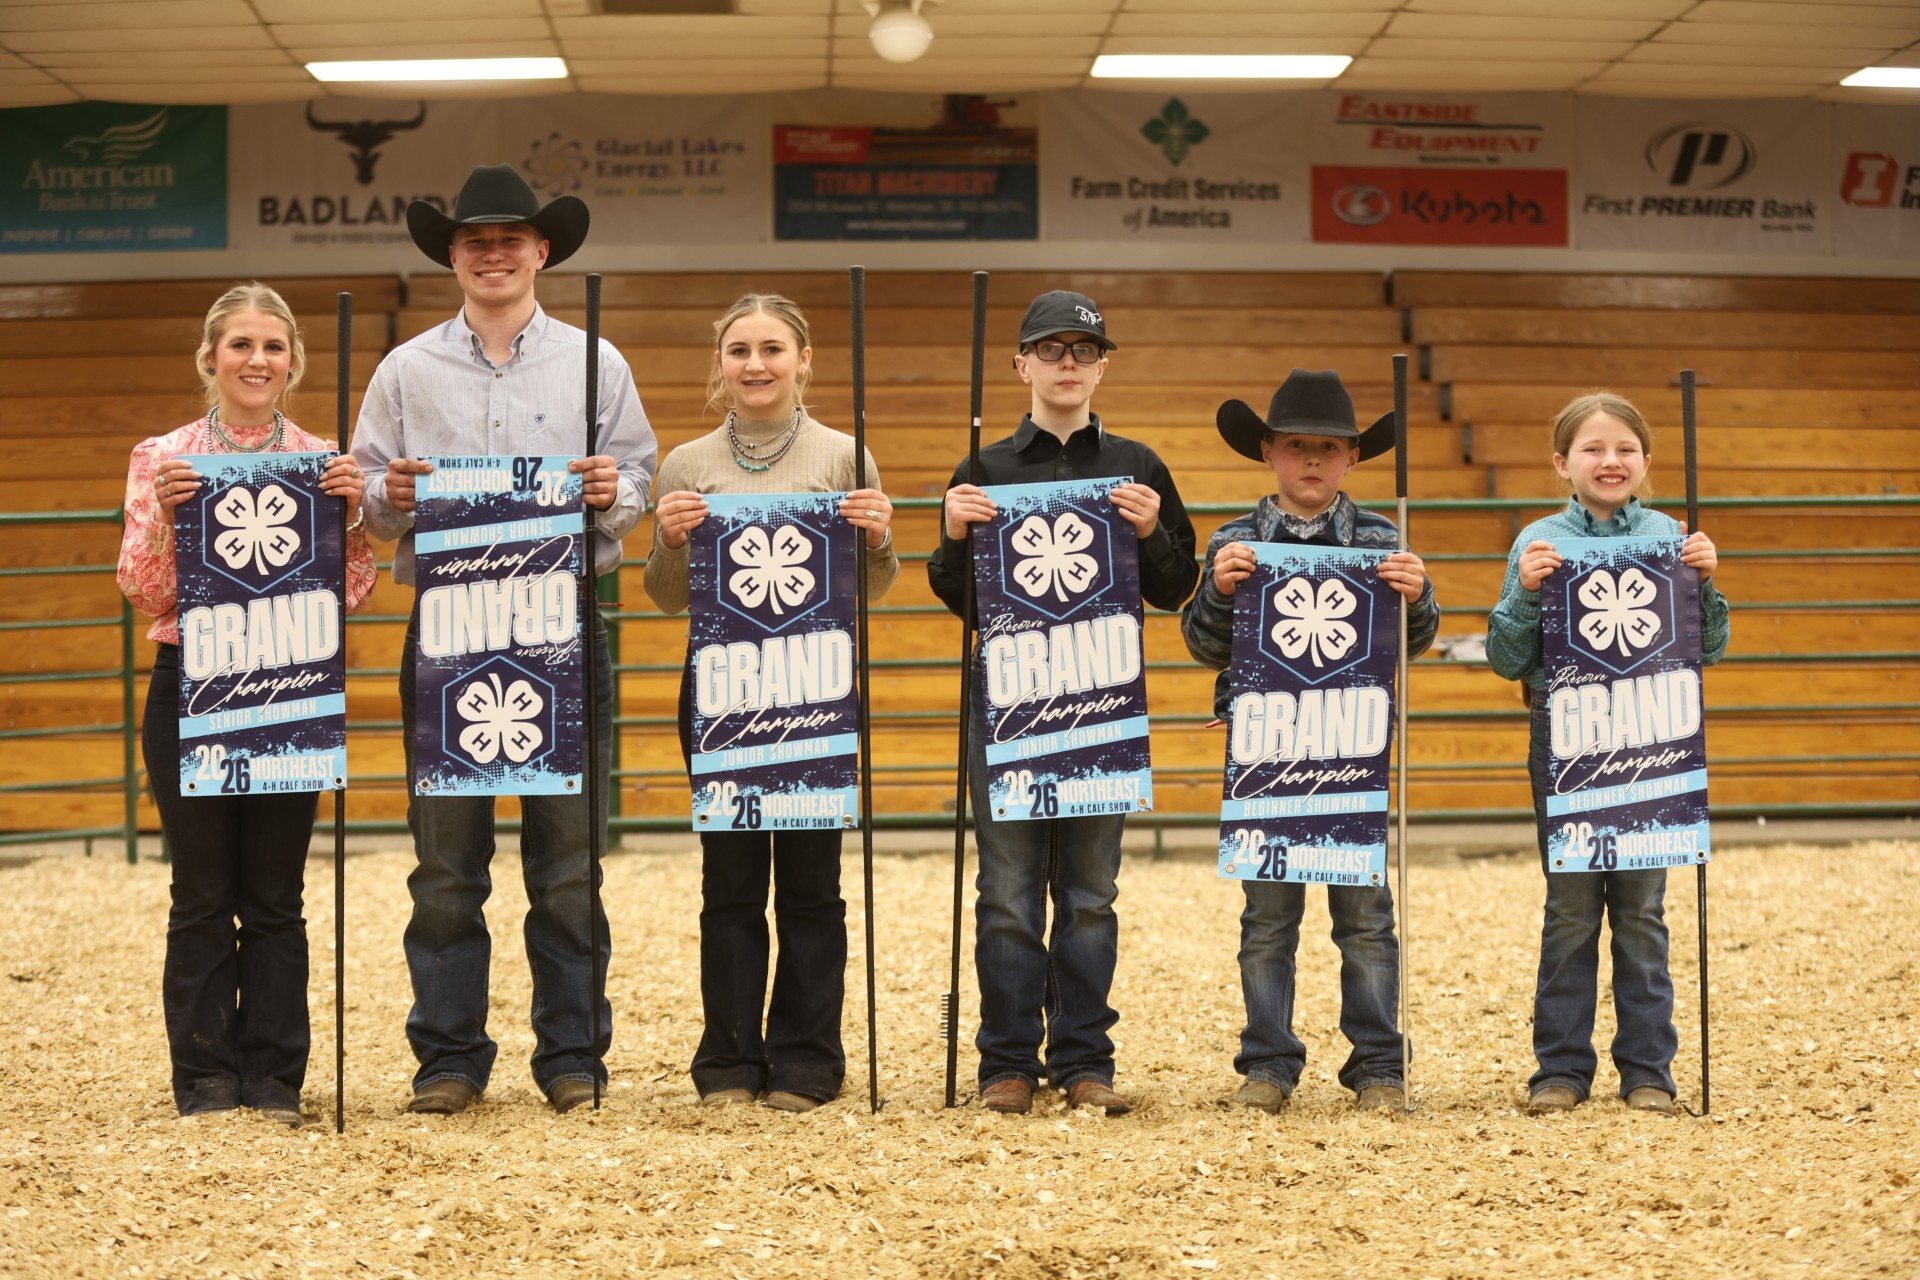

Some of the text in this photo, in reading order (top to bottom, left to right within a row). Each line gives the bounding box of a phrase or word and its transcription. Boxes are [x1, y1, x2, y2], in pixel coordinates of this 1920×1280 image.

[595, 137, 745, 155] Glacial Lakes
[1370, 128, 1543, 153] EQUIPMENT
[20, 158, 175, 189] American
[684, 159, 724, 177] LLC
[815, 171, 998, 195] TITAN MACHINERY
[109, 191, 157, 209] Trust
[1071, 176, 1281, 200] Farm Credit Services
[1122, 206, 1231, 232] of America
[1401, 190, 1546, 224] Kubota
[1582, 194, 1816, 220] First PREMIER Bank
[439, 459, 500, 468] 4-H CALF SHOW
[428, 457, 567, 506] 20 26 NORTHEAST
[444, 519, 552, 547] SENIOR SHOWMAN
[430, 534, 573, 590] Champion
[420, 570, 577, 658] GRAND
[983, 613, 1045, 641] Reserve
[184, 589, 339, 681] GRAND
[514, 639, 578, 665] Reserve
[987, 614, 1140, 709] GRAND
[188, 660, 330, 717] Champion
[697, 630, 852, 718] GRAND
[1548, 666, 1608, 692] Reserve
[209, 700, 316, 730] SENIOR SHOWMAN
[700, 697, 842, 754] Champion
[994, 685, 1133, 744] Champion
[1232, 687, 1389, 765] GRAND
[1551, 669, 1700, 760] GRAND
[721, 739, 829, 767] JUNIOR SHOWMAN
[1016, 725, 1122, 757] JUNIOR SHOWMAN
[195, 745, 335, 794] 20 26 NORTHEAST
[1231, 747, 1374, 805] Champion
[1555, 739, 1692, 796] Champion
[263, 779, 323, 791] 4-H CALF SHOW
[1003, 770, 1140, 817] 20 26 NORTHEAST
[1569, 776, 1688, 811] BEGINNER SHOWMAN
[707, 781, 846, 829] 20 26 NORTHEAST
[1071, 801, 1130, 814] 4-H CALF SHOW
[1244, 795, 1366, 816] BEGINNER SHOWMAN
[774, 818, 835, 827] 4-H CALF SHOW
[1233, 828, 1372, 880] 20 26 NORTHEAST
[1563, 822, 1698, 870] 20 26 NORTHEAST
[1629, 855, 1688, 867] 4-H CALF SHOW
[1298, 872, 1359, 883] 4-H CALF SHOW
